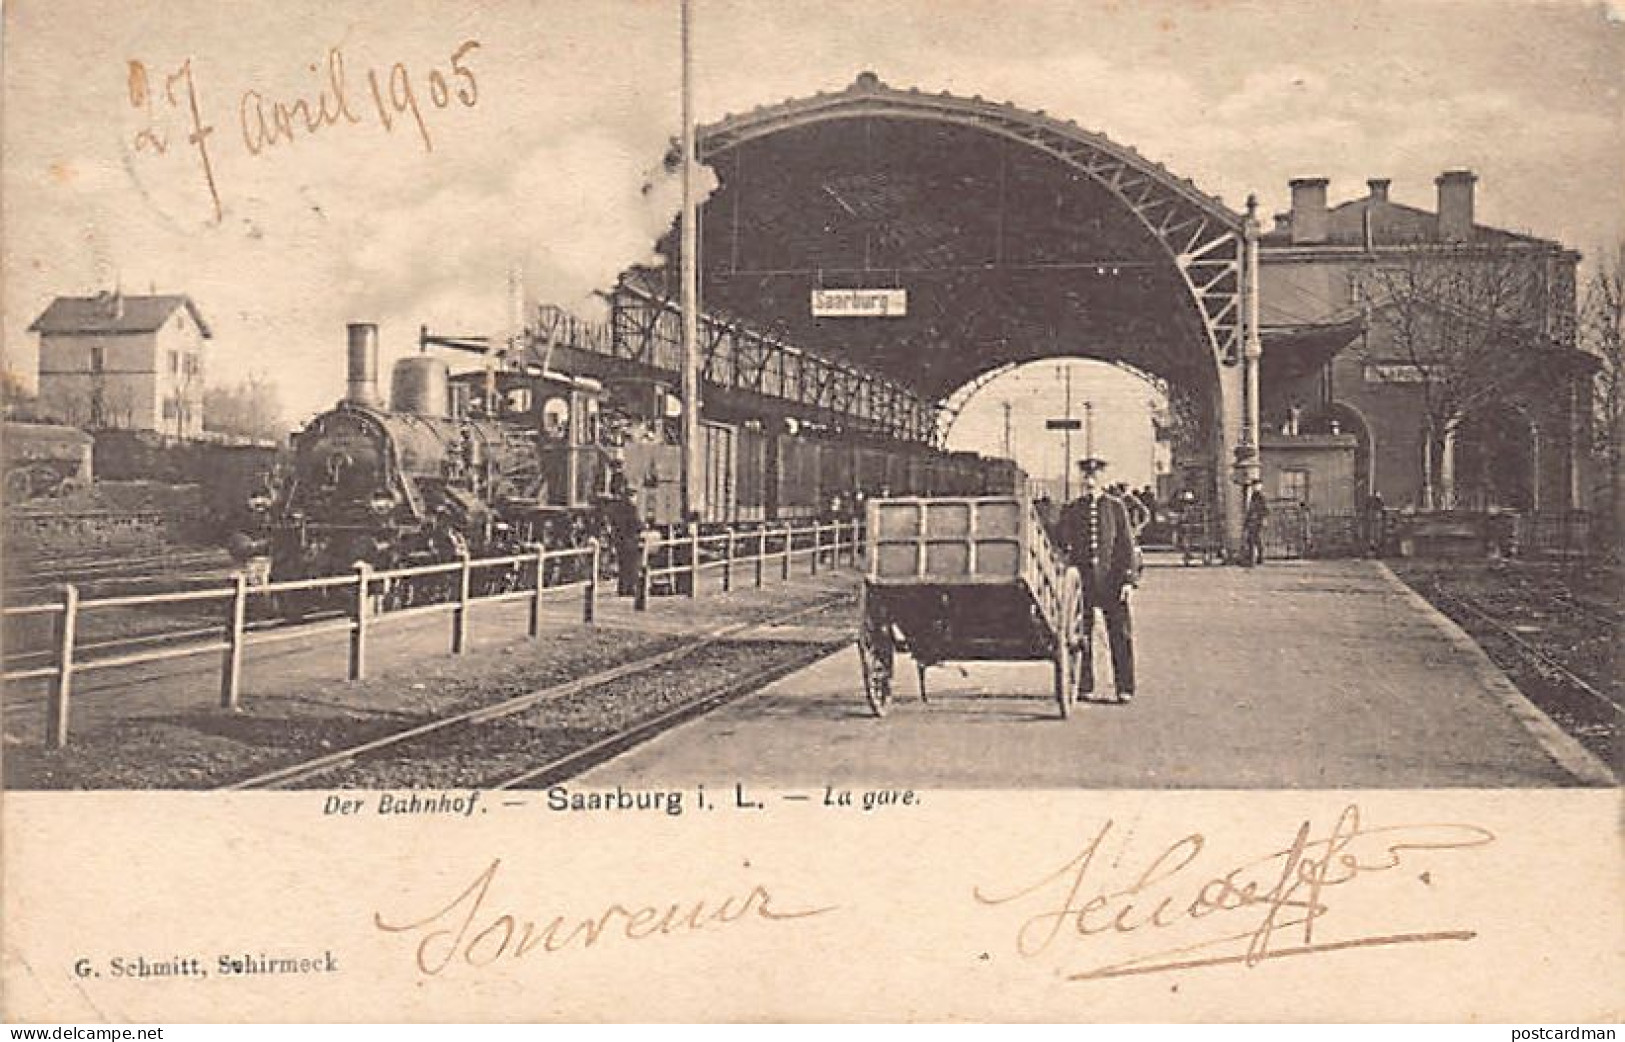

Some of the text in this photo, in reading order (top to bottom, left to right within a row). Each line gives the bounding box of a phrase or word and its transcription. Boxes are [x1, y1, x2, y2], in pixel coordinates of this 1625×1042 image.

[367, 40, 481, 153] 1905
[814, 291, 889, 315] Saarburg
[323, 783, 921, 817] Der Bahnhof. Saarburg i. L. La gare.
[375, 857, 840, 976] Souvenir
[74, 957, 101, 978] G.
[110, 955, 209, 979] Schmitt,
